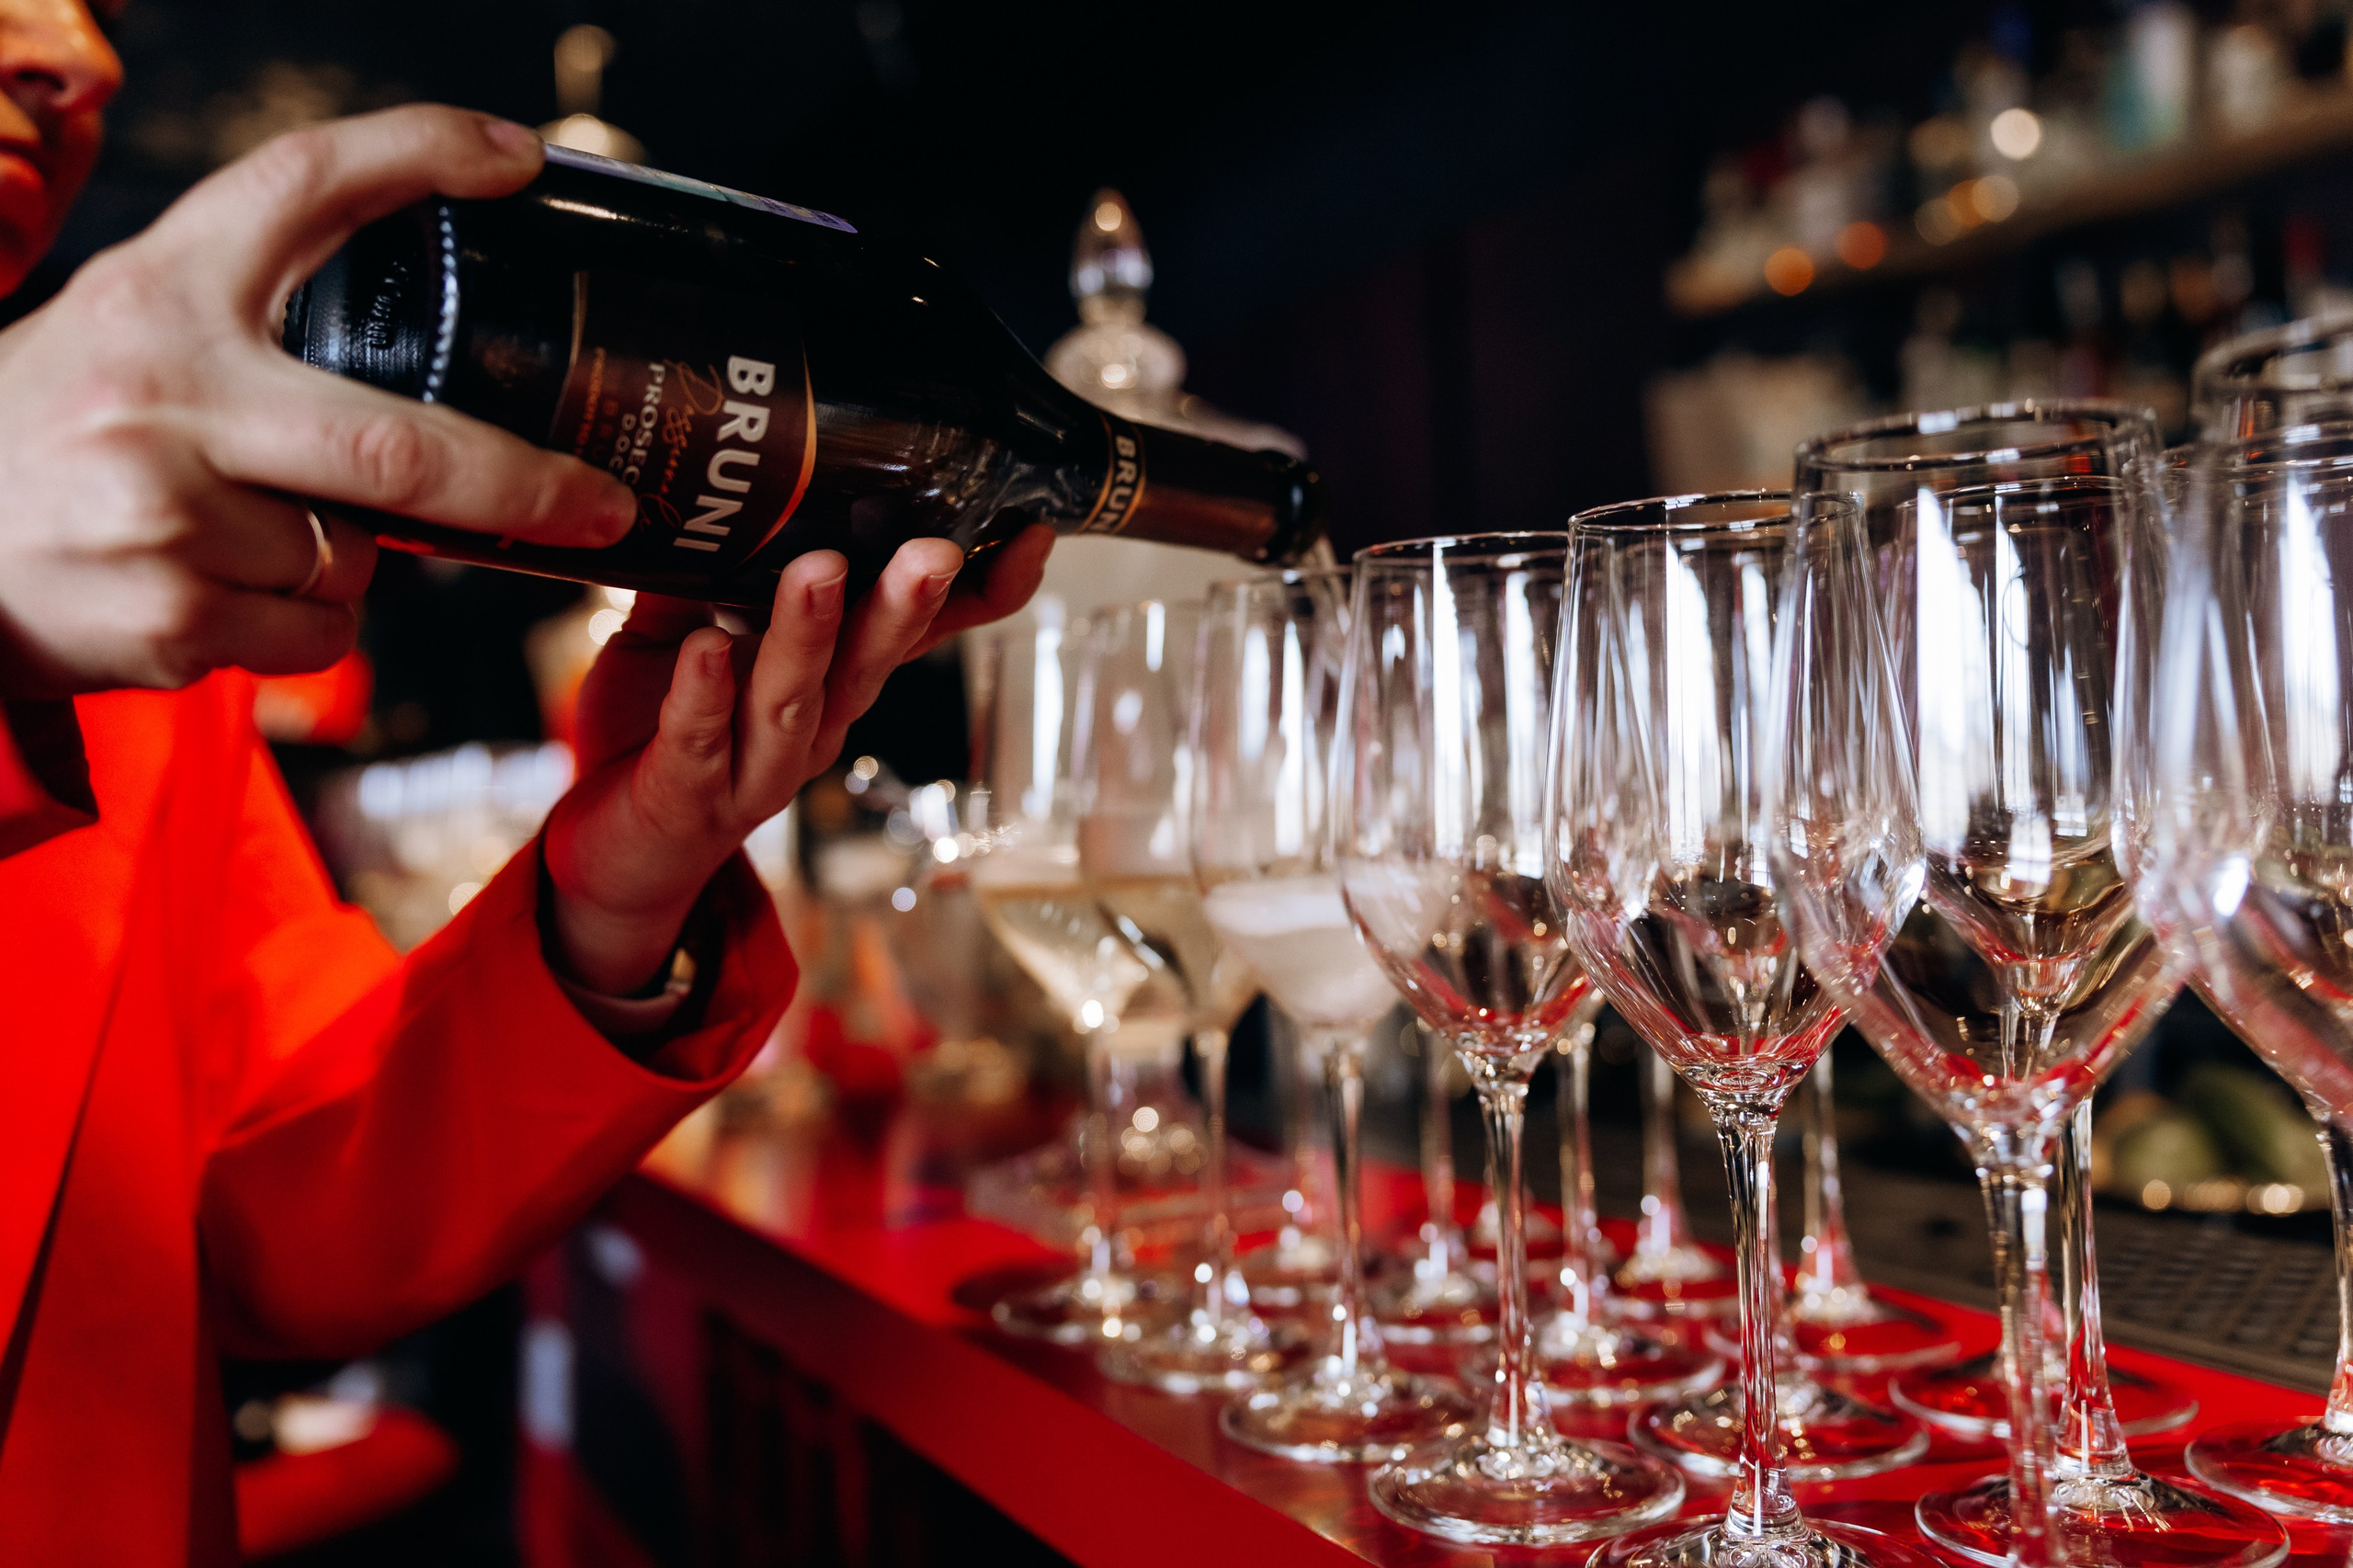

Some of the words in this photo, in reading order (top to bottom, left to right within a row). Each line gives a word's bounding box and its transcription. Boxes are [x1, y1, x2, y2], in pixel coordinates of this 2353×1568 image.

[622, 362, 666, 485] PROSEC
[672, 355, 776, 552] BRUNI
[1089, 435, 1138, 530] BRUN
